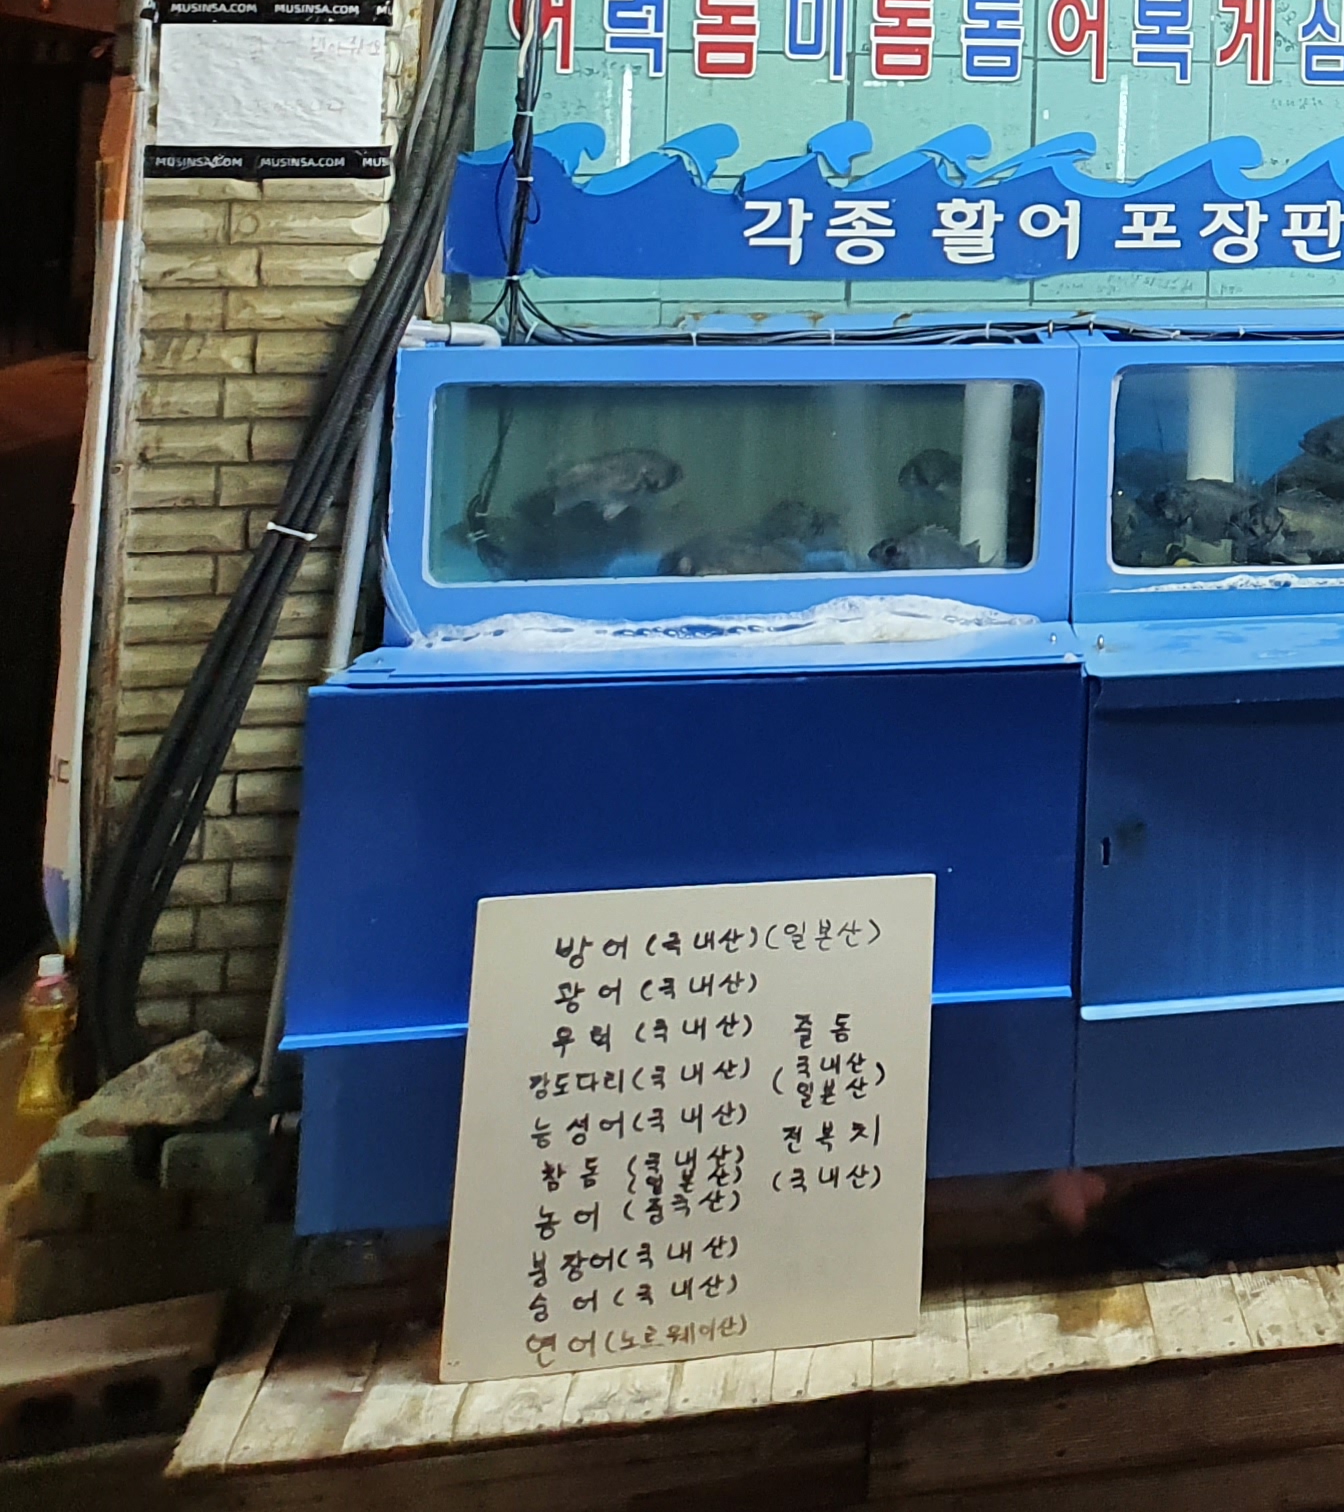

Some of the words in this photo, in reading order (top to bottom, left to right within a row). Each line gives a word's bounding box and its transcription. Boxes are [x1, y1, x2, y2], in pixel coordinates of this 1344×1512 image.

[170, 2, 258, 14] MUSINSA.COM
[274, 3, 360, 15] MUSINSA.COM
[155, 155, 243, 168] MUSINSA.COM
[260, 156, 346, 168] MUSINSA.COM
[743, 198, 897, 266] 각종
[931, 198, 1084, 265] 활어
[555, 934, 628, 969] 방어
[553, 977, 622, 1014] 광어
[551, 1023, 611, 1058] 우럭
[526, 1329, 596, 1368] 연어
